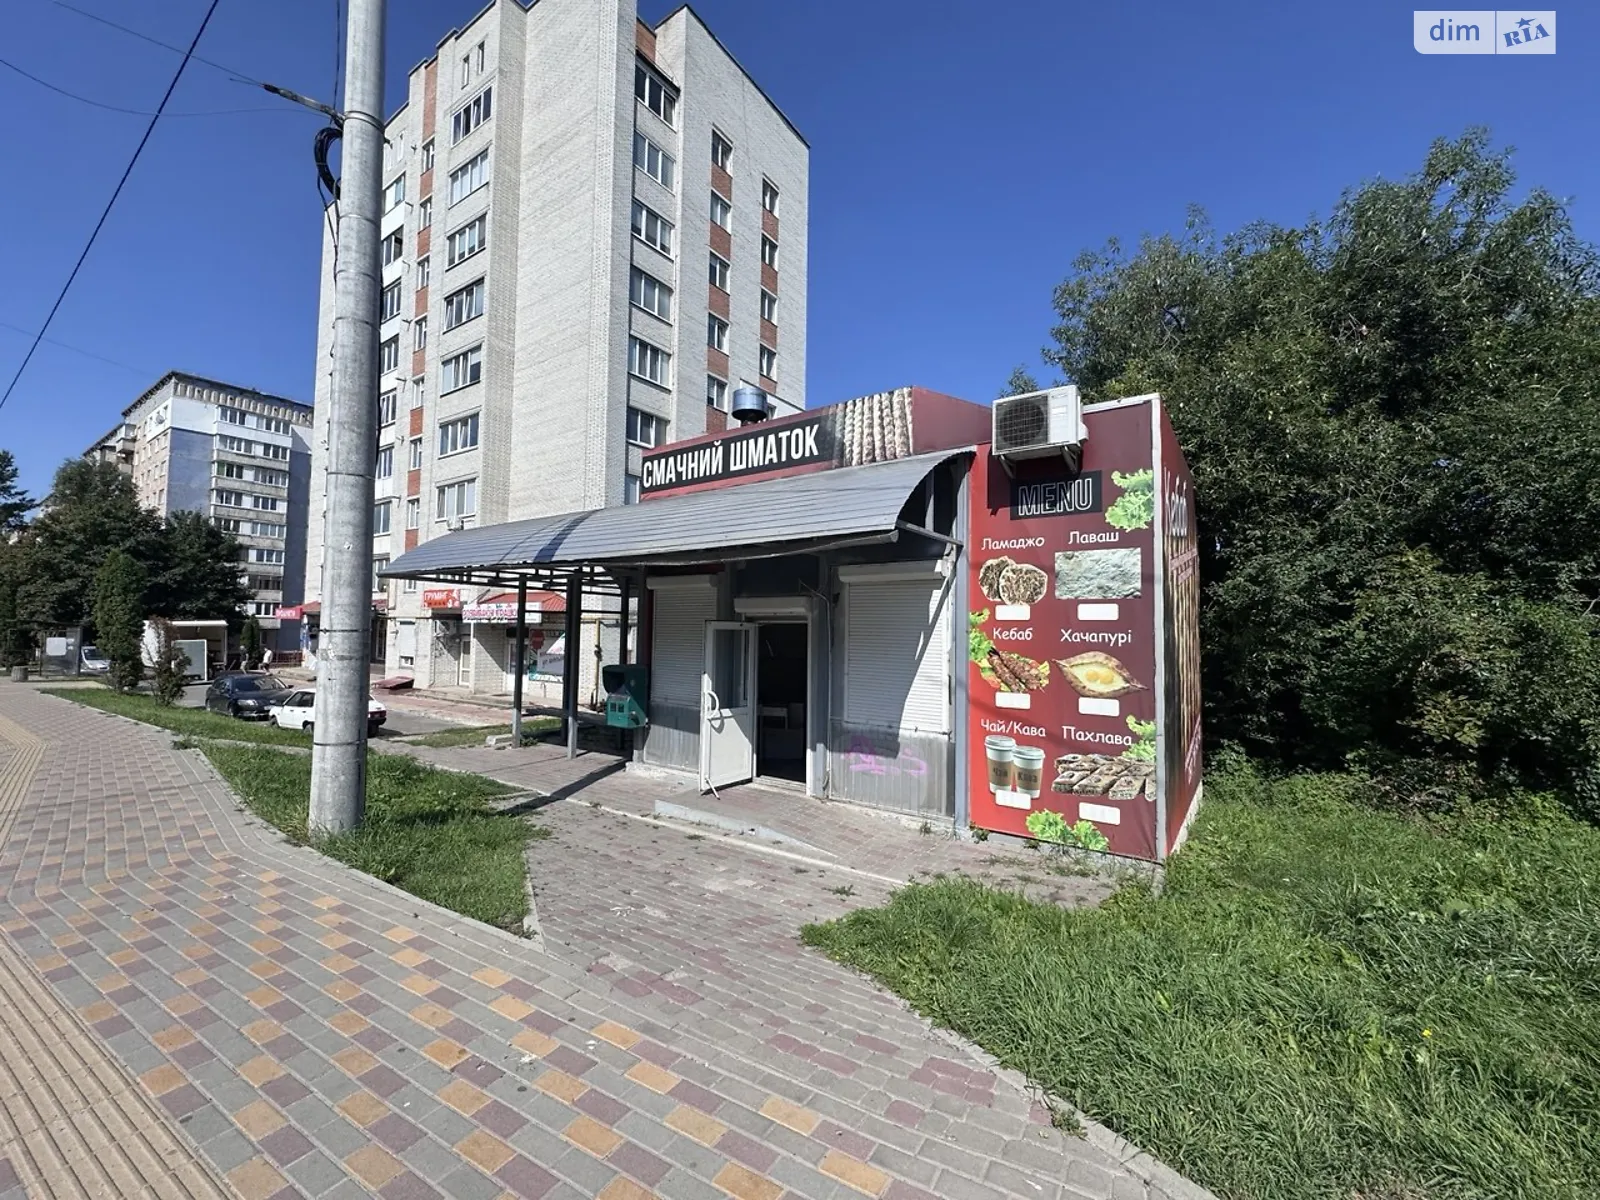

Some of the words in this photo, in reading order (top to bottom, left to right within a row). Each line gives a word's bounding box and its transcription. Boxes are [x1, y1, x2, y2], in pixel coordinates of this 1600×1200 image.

[643, 440, 723, 488] СМАЧНИЙ
[729, 424, 819, 472] ШМАТОК
[1018, 477, 1093, 516] MENU
[981, 536, 1045, 550] Ламаджо
[1068, 531, 1119, 545] Лаваш
[993, 627, 1033, 641] Кебаб
[1060, 629, 1132, 646] Хачапурі
[980, 718, 1047, 738] Чай/Кава
[1061, 725, 1132, 746] Пахлава
